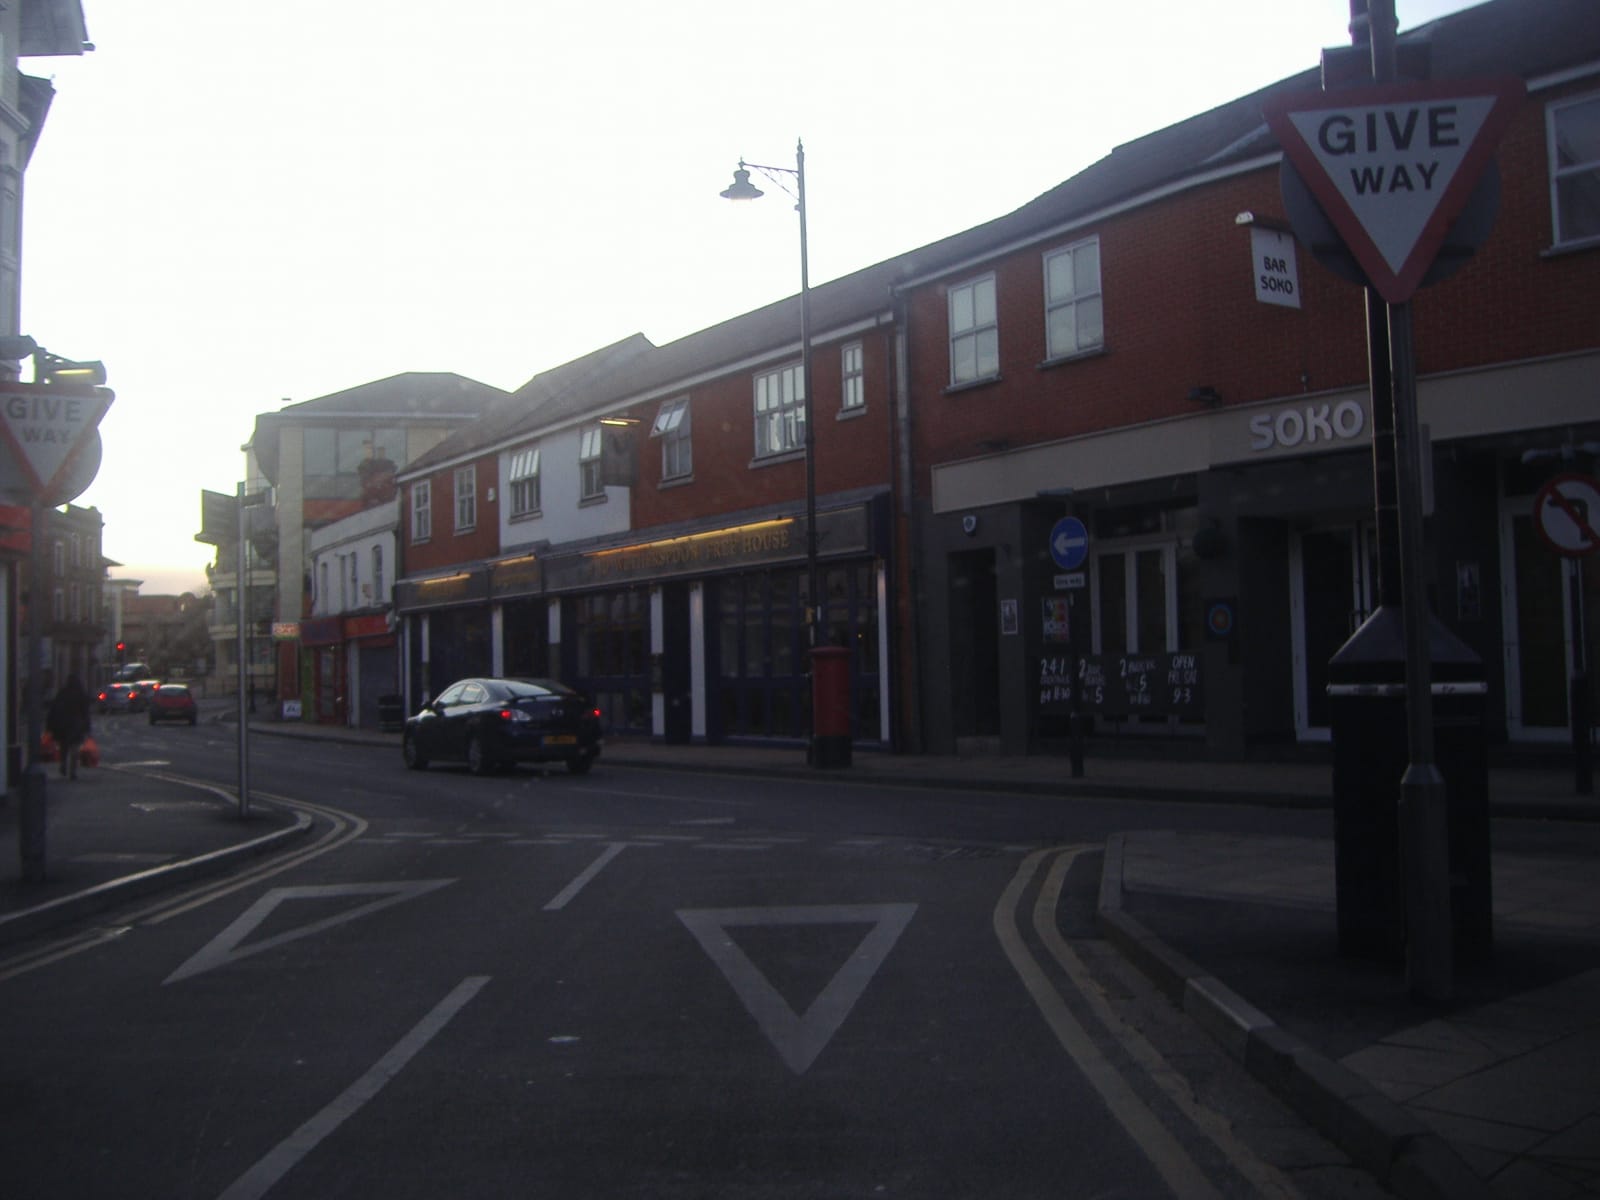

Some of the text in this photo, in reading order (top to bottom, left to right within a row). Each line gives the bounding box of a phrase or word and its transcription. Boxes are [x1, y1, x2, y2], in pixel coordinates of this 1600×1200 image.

[1318, 106, 1460, 156] GIVE
[1350, 161, 1440, 195] WAY
[1263, 256, 1287, 273] BAR
[1260, 275, 1294, 295] SOKO
[6, 396, 81, 421] GIVE
[22, 427, 71, 443] WAY
[1249, 399, 1364, 452] SOKO
[742, 528, 791, 554] HOUSE
[1172, 656, 1195, 669] OPEN
